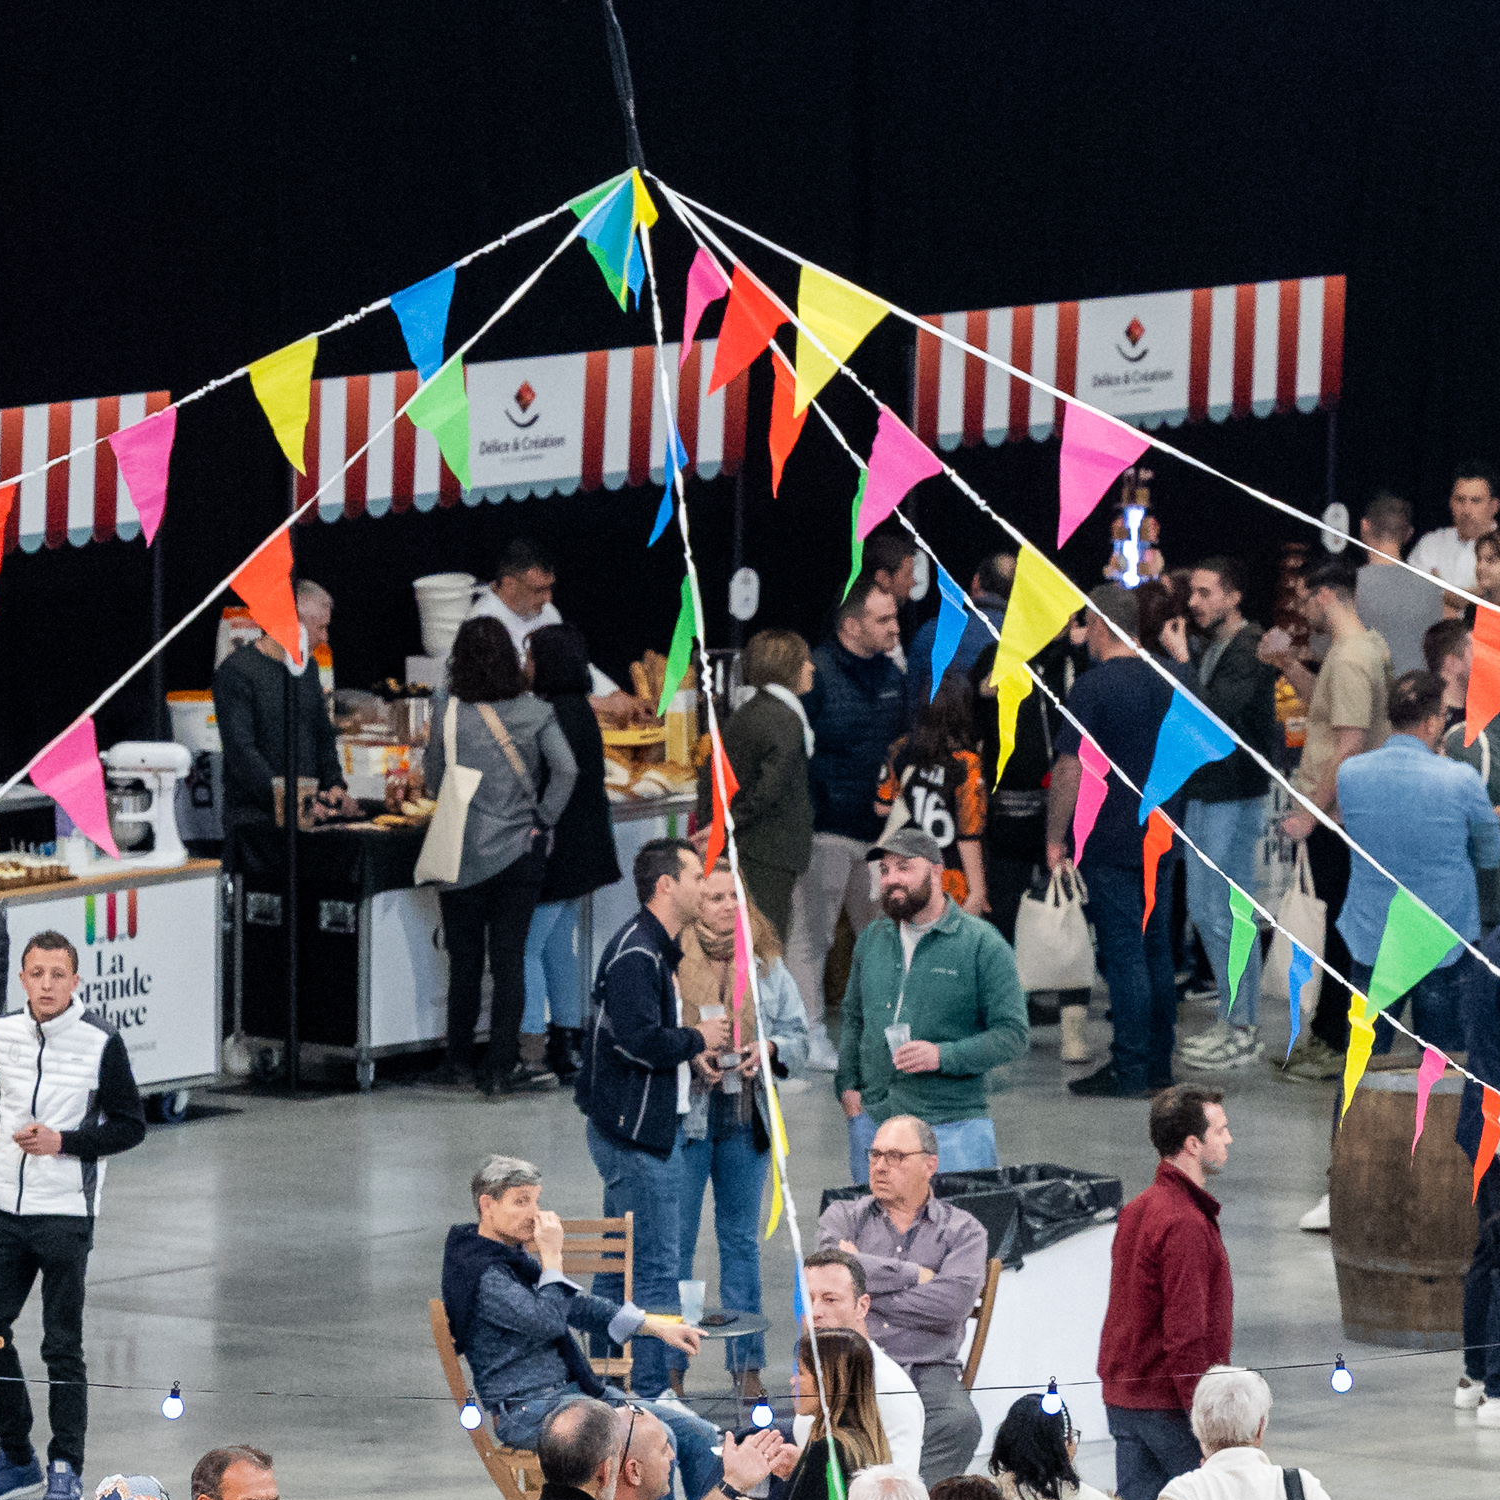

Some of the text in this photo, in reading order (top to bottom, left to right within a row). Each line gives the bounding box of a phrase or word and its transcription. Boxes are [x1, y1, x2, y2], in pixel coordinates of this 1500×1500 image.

[911, 785, 956, 848] 16
[96, 950, 124, 977] La
[80, 967, 152, 1004] rande
